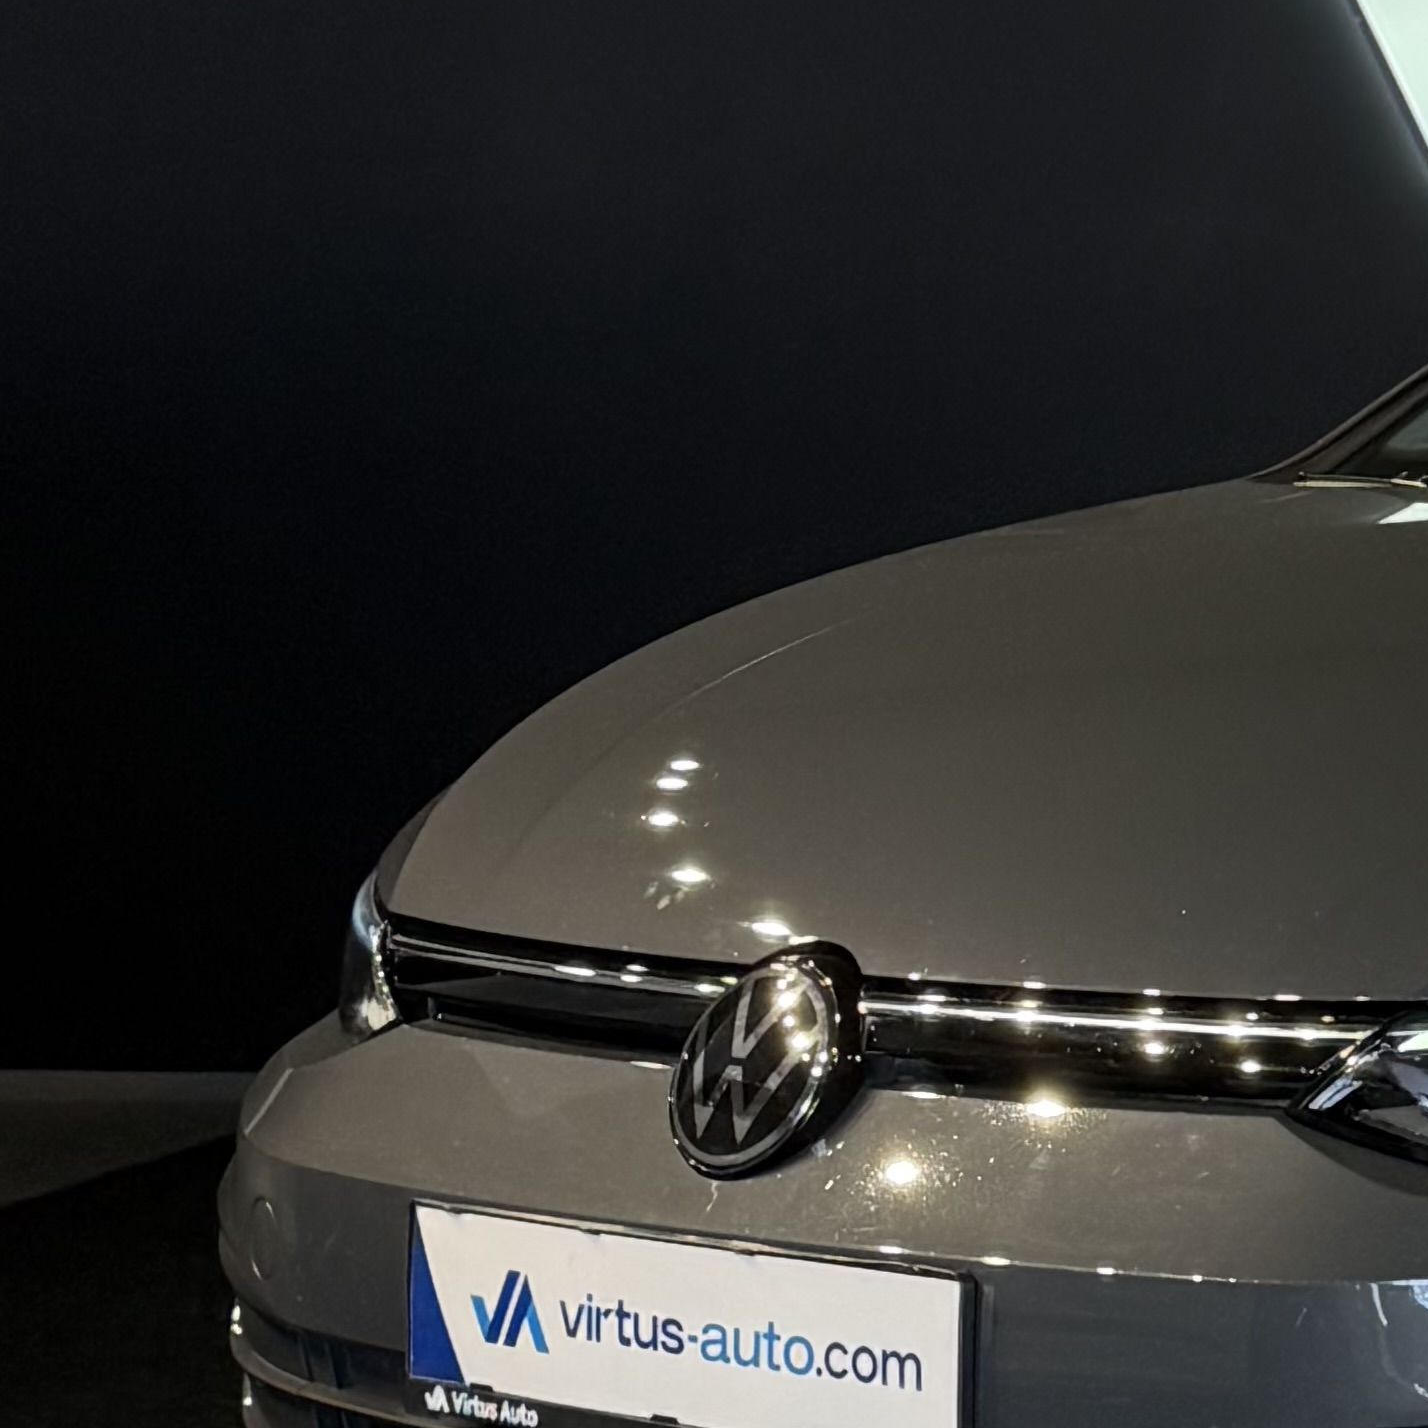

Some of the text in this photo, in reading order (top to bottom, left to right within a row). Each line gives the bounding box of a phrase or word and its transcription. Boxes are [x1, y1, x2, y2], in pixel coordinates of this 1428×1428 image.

[559, 1292, 923, 1392] virtus-auto.com
[451, 1390, 498, 1422] Virtus
[500, 1399, 539, 1428] Auto
